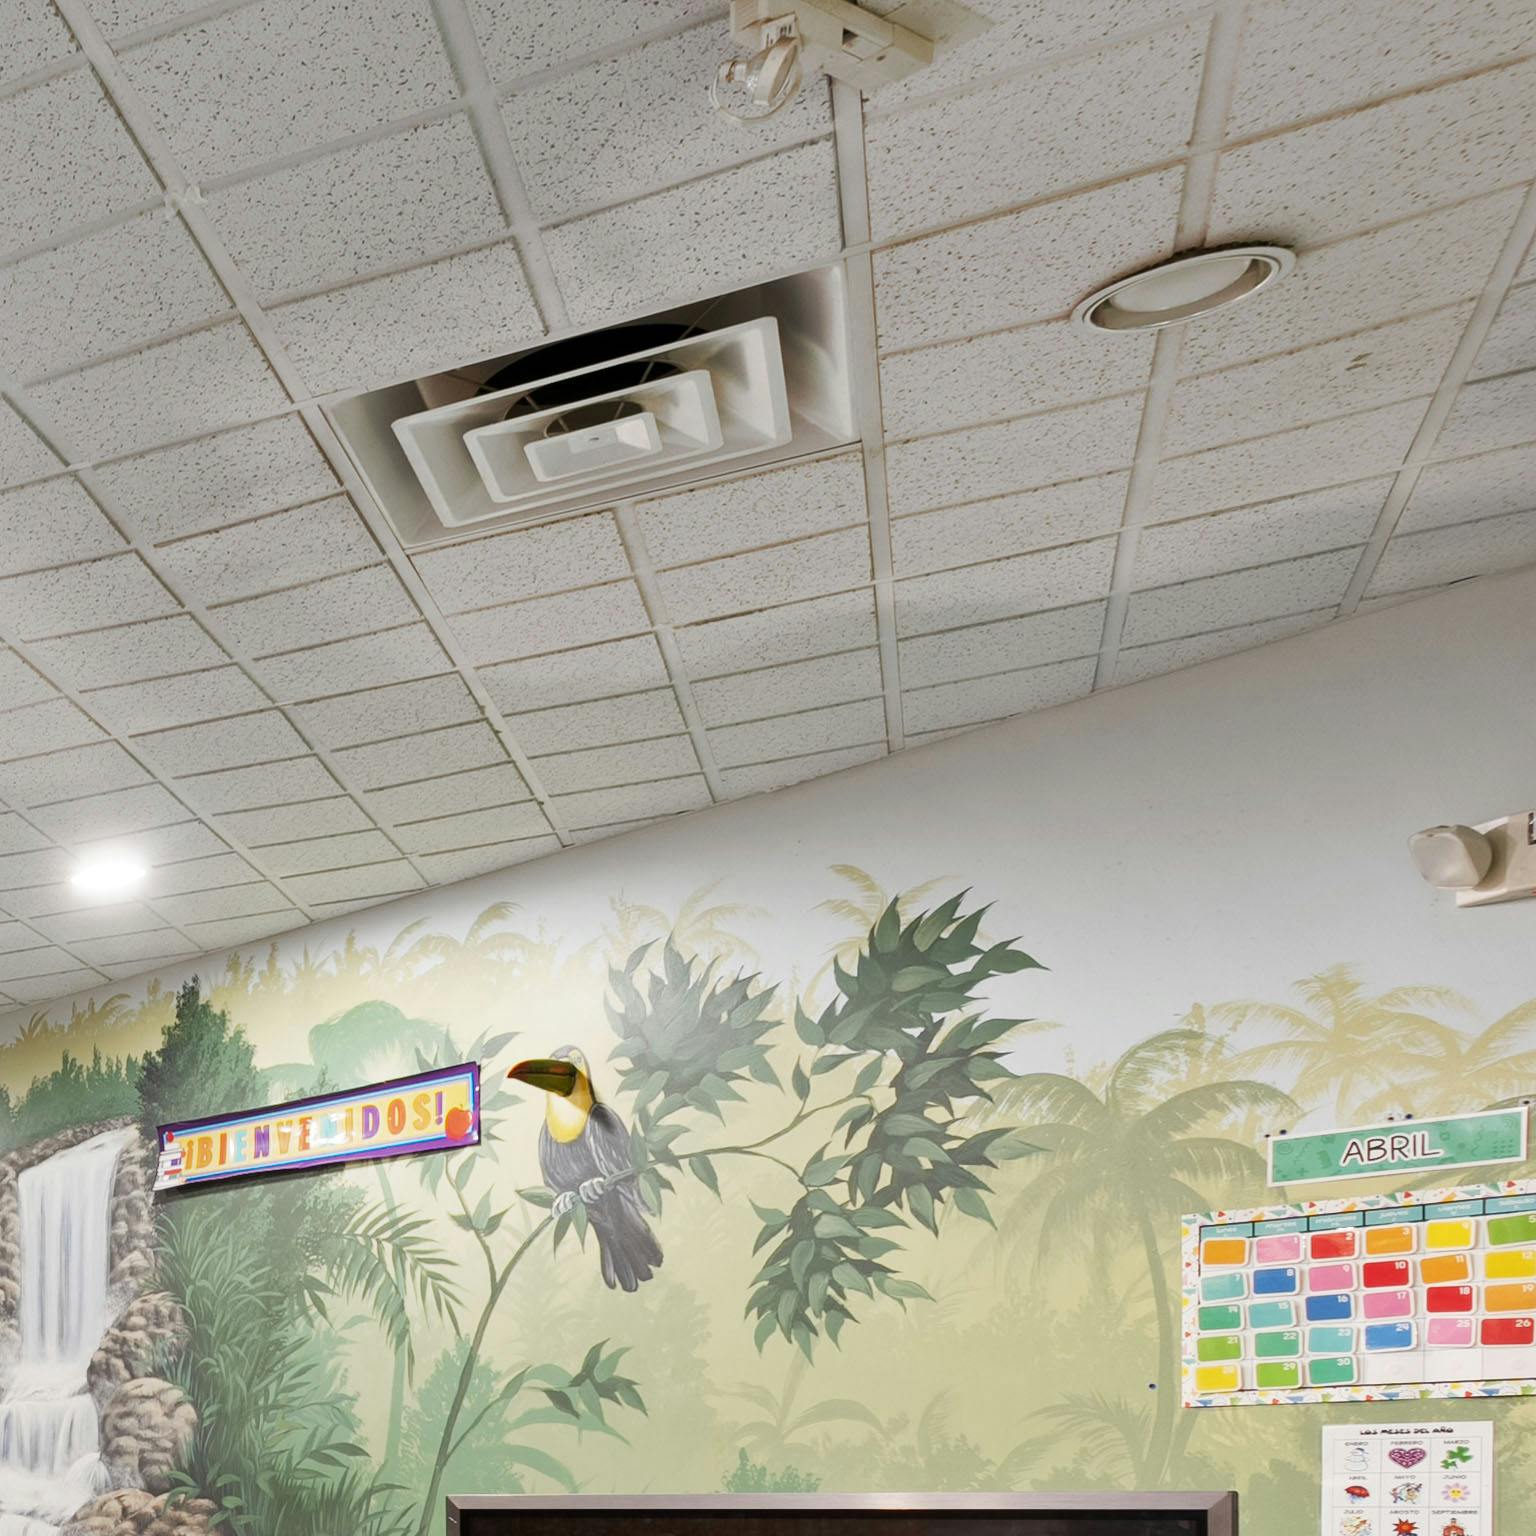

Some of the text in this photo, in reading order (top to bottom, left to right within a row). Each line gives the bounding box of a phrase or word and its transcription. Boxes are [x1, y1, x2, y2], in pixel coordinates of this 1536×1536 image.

[1342, 1133, 1442, 1164] ABRIL
[1456, 1255, 1464, 1263] 11
[1459, 1287, 1470, 1295] 18
[1456, 1319, 1470, 1328] 25
[1515, 1319, 1531, 1328] 26
[1283, 1363, 1296, 1371] 29
